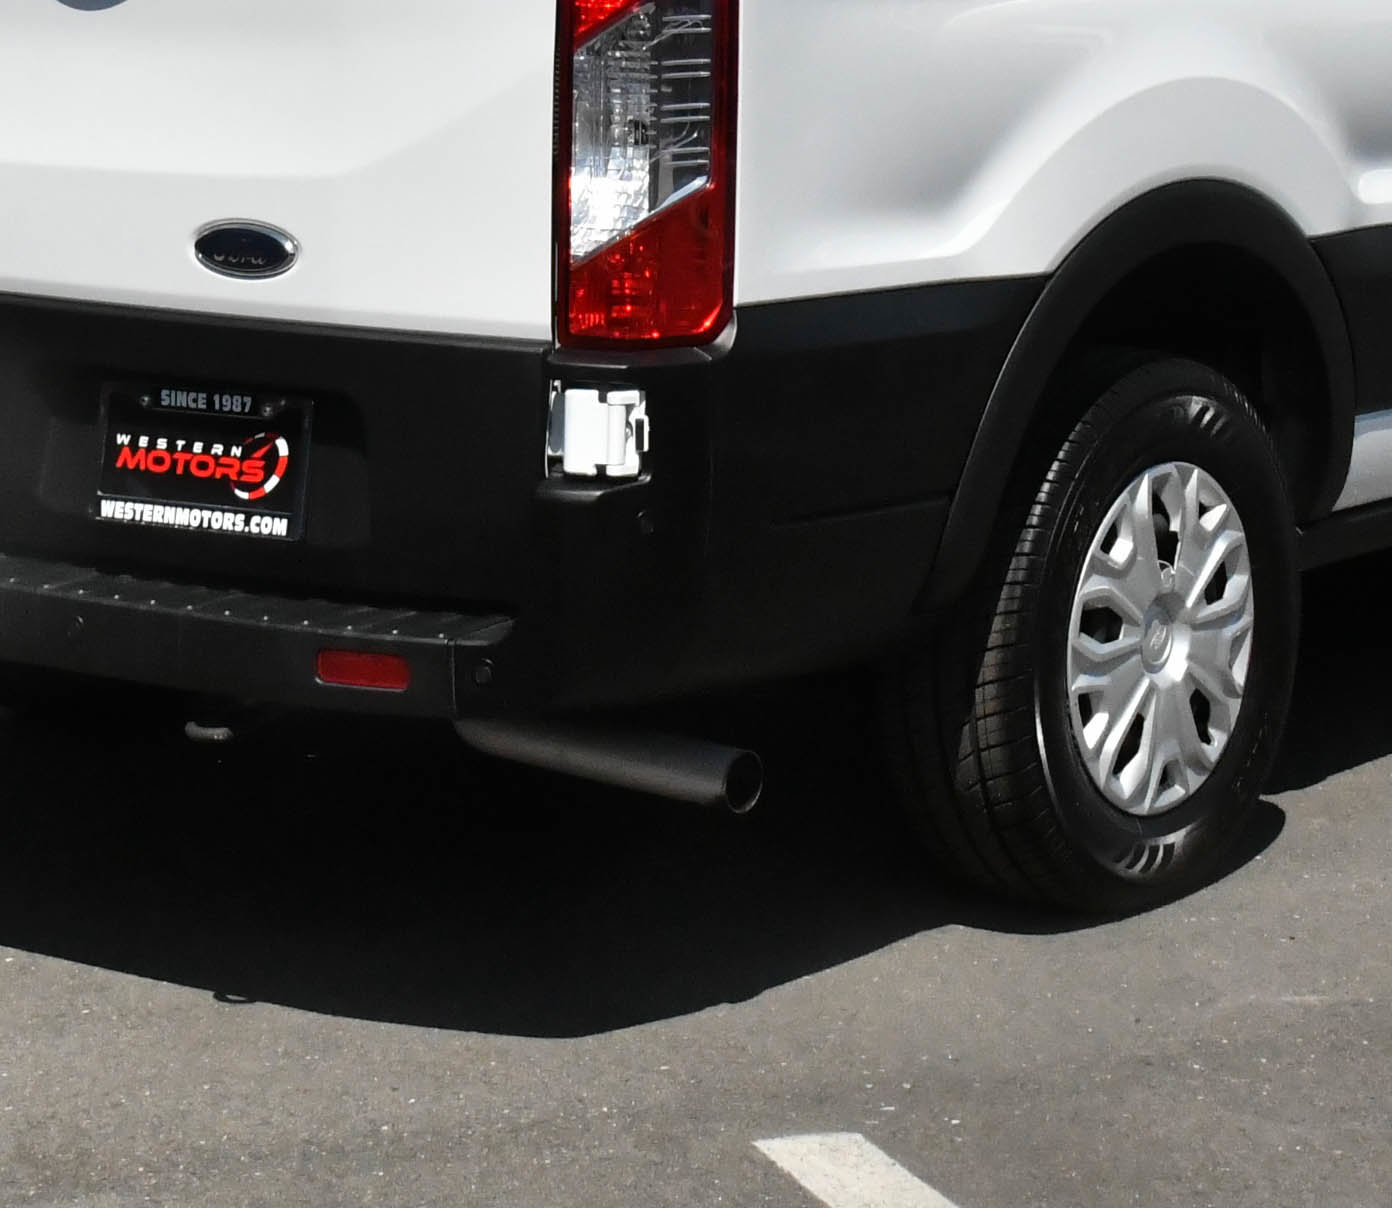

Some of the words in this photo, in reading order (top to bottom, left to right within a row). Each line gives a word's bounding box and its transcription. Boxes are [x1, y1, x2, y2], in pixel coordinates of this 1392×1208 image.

[160, 389, 207, 409] SINCE
[213, 394, 252, 413] 1987
[116, 433, 242, 457] WESTERN
[116, 446, 265, 483] MOTORS
[100, 500, 288, 536] WESTERNMOTORS.COM
